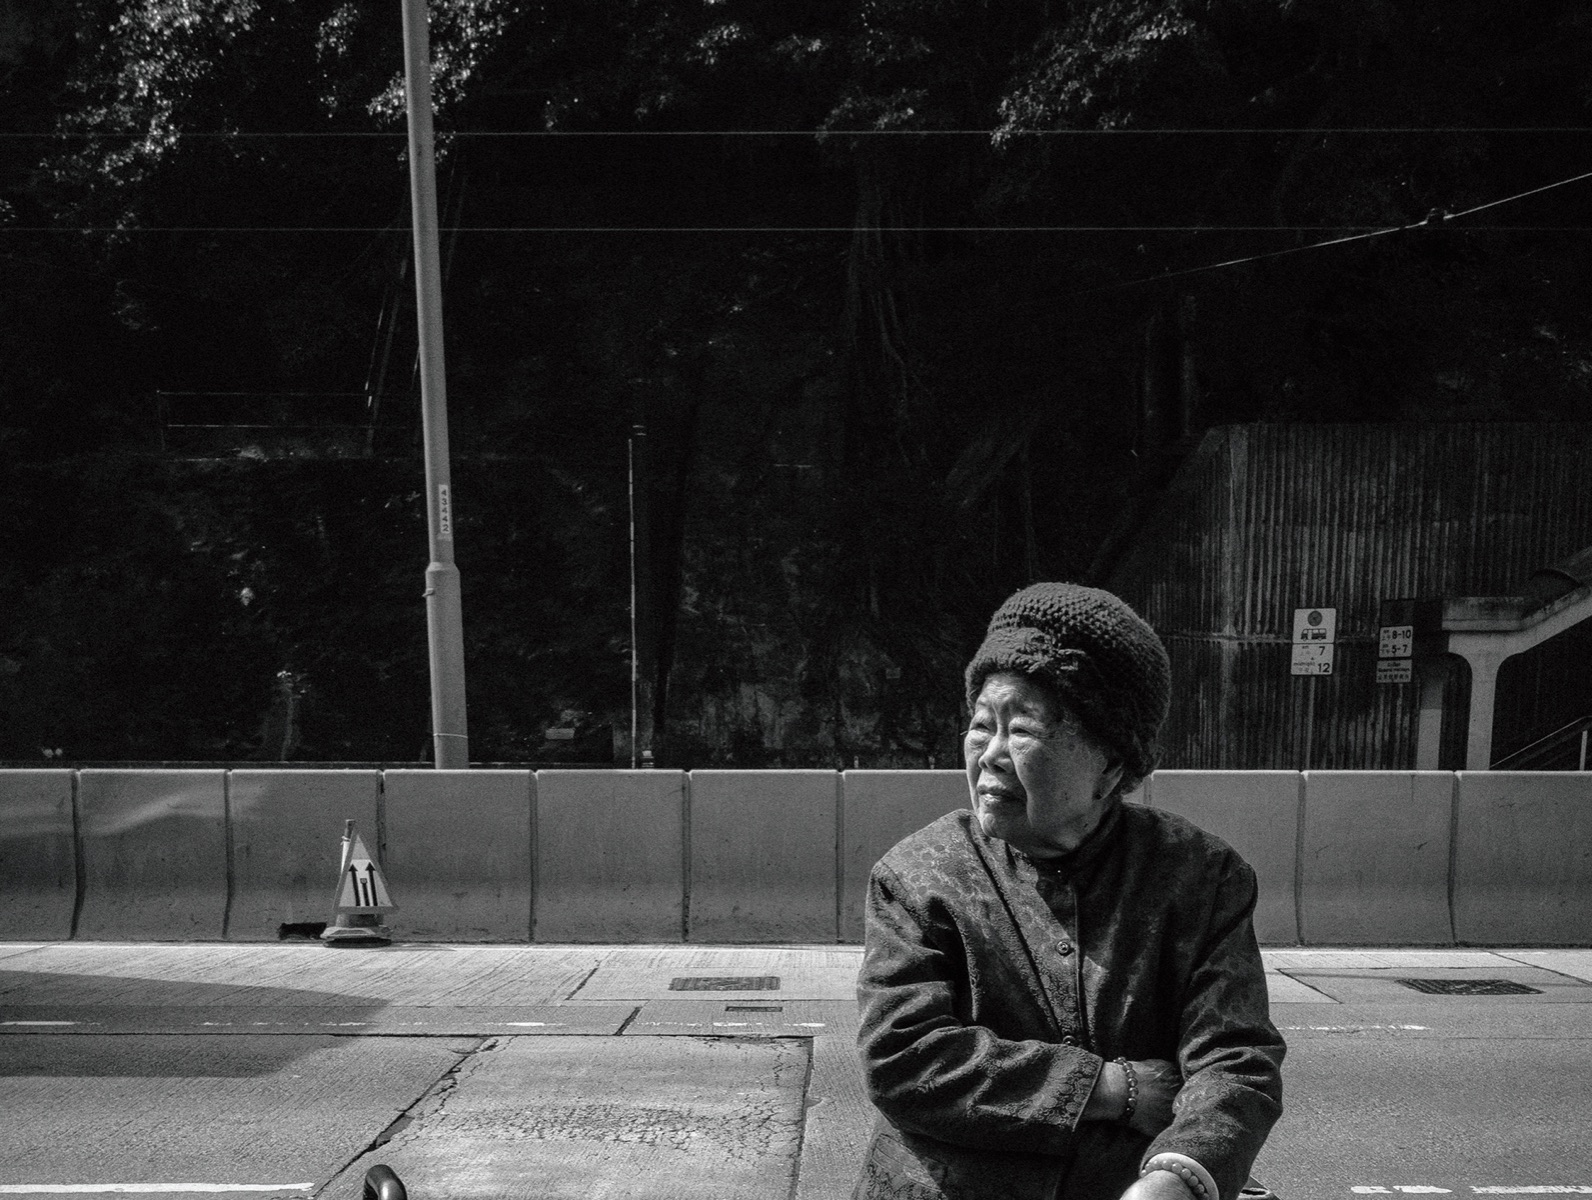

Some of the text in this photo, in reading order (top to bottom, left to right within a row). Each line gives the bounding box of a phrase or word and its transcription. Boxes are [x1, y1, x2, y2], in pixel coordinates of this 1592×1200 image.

[1392, 630, 1411, 639] 8-10
[1319, 645, 1326, 656] 7
[1392, 644, 1408, 654] 5-7
[1317, 662, 1331, 673] 12
